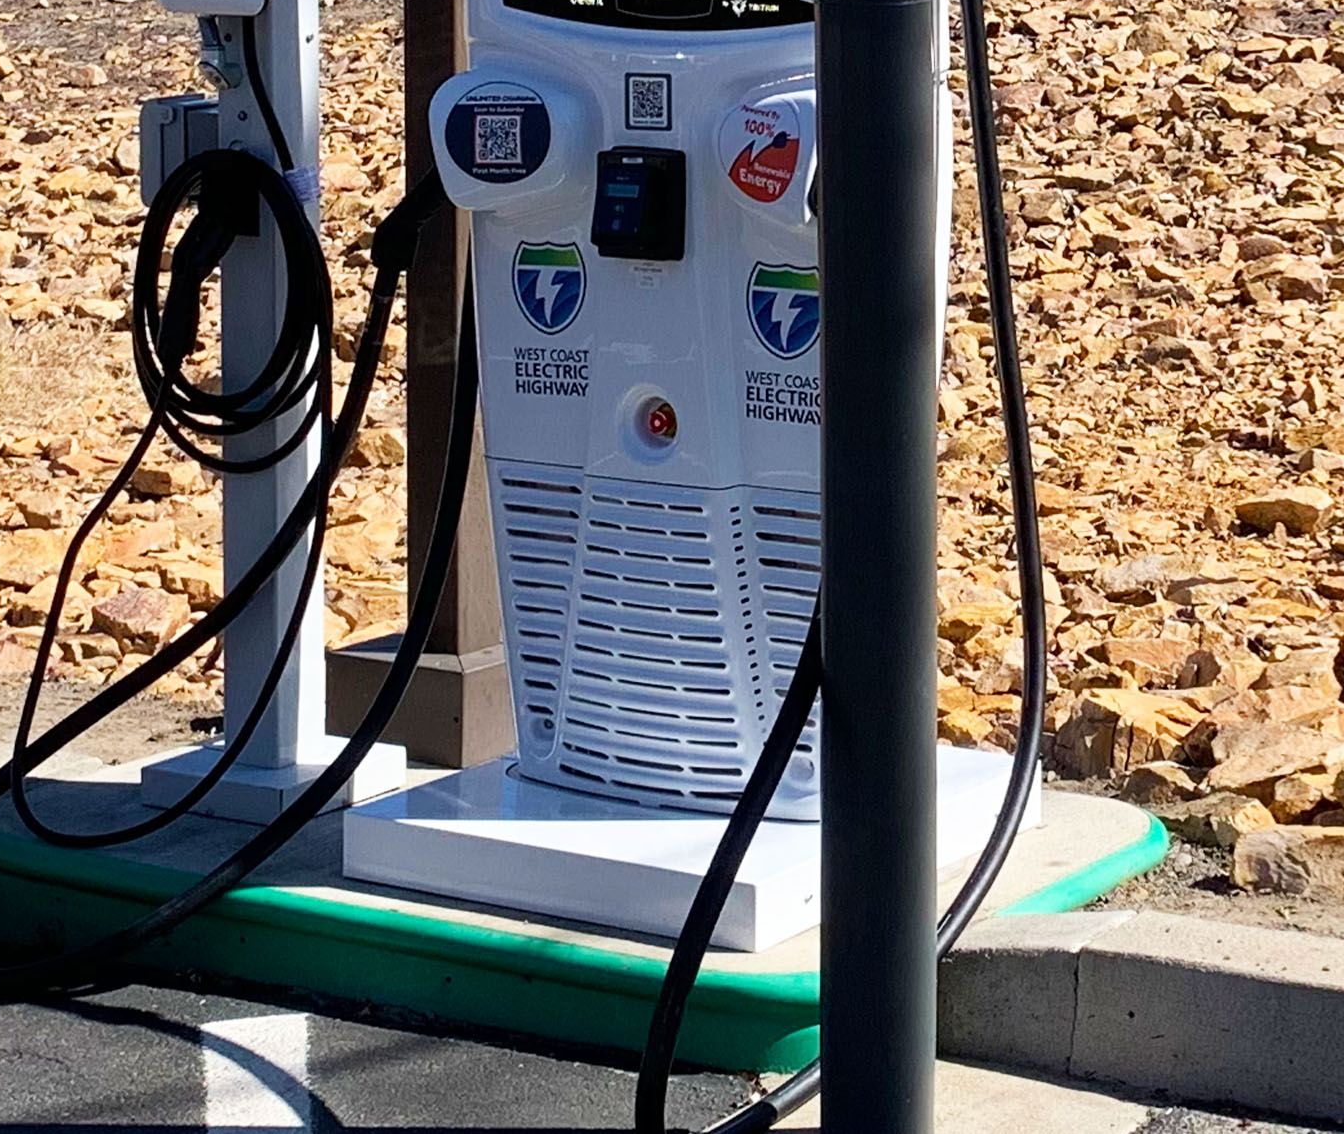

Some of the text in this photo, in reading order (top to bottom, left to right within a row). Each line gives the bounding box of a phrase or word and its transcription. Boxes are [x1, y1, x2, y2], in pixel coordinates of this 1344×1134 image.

[744, 118, 776, 138] 100%
[739, 168, 781, 195] Energy
[514, 347, 589, 363] WEST COAST
[515, 362, 589, 380] ELECTRIC
[745, 370, 820, 391] WEST COAS
[516, 379, 589, 397] HIGHWAY
